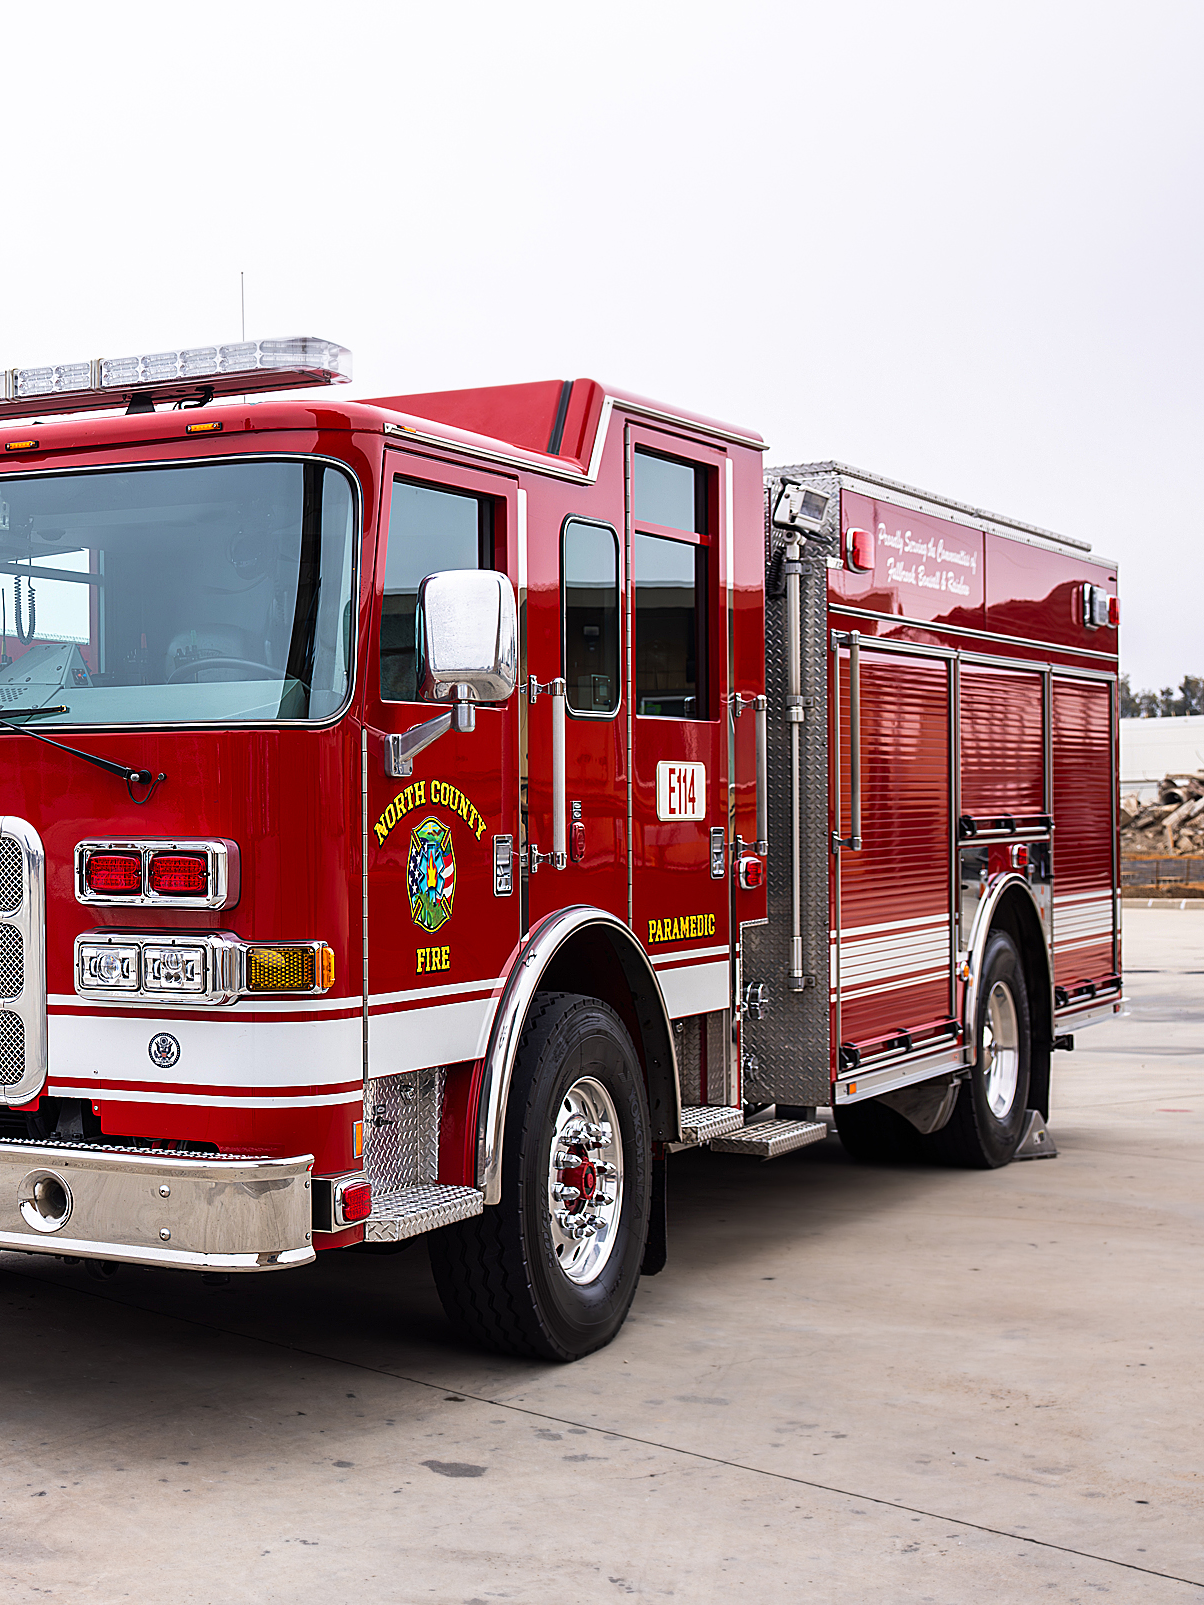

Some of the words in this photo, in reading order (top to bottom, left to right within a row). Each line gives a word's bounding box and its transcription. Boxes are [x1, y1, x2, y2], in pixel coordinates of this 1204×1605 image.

[668, 768, 696, 815] E114
[373, 780, 427, 848] NORTH
[430, 779, 488, 841] COUNTY
[648, 913, 716, 945] PARAMEDIC
[416, 946, 451, 975] FIRE
